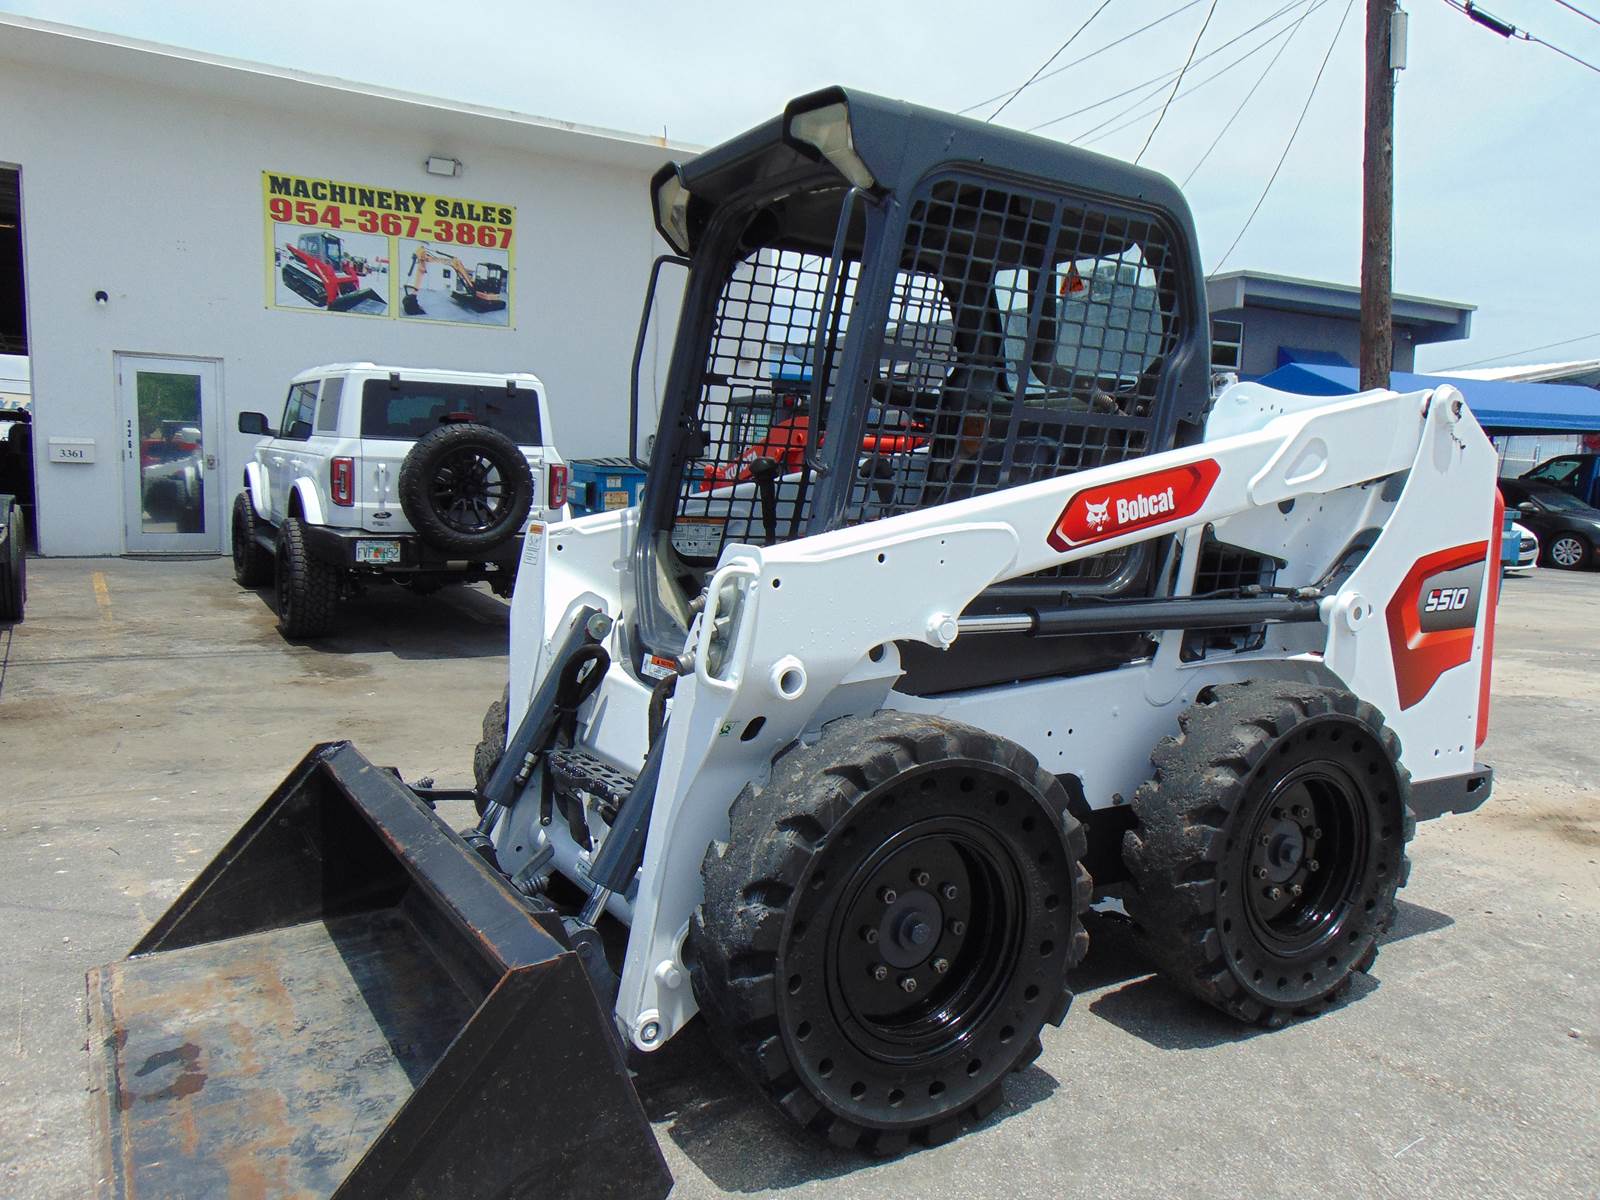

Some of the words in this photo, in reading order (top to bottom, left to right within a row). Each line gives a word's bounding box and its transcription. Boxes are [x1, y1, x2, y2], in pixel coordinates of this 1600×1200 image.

[269, 175, 426, 215] MACHINERY
[435, 199, 513, 226] SALES
[269, 197, 513, 249] 954-367-3867
[59, 448, 84, 458] 3361
[1116, 487, 1175, 524] Bobcat
[1425, 588, 1469, 612] S510
